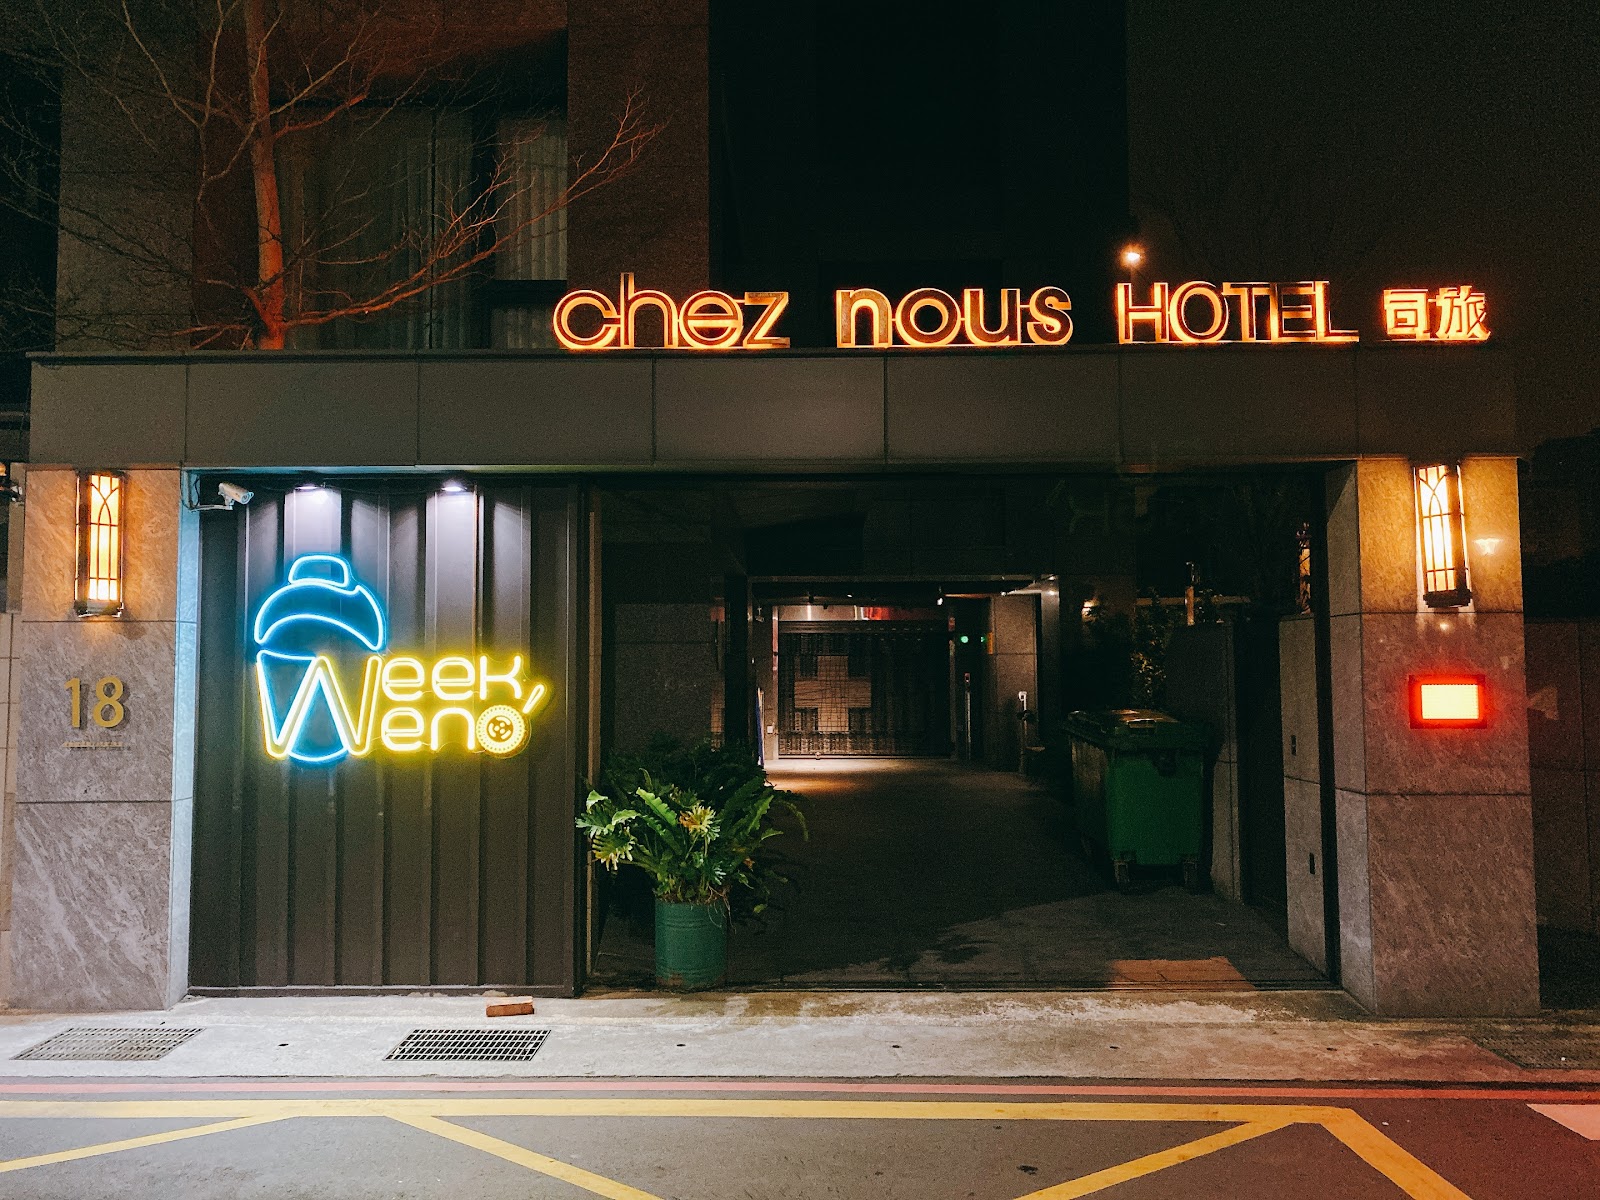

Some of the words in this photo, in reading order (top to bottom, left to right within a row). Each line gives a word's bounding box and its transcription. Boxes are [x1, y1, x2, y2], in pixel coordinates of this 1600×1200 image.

[552, 272, 791, 348] chez
[836, 286, 1074, 348] nous
[1116, 281, 1360, 343] HOTEL
[64, 676, 125, 728] 18
[256, 650, 523, 758] Week
